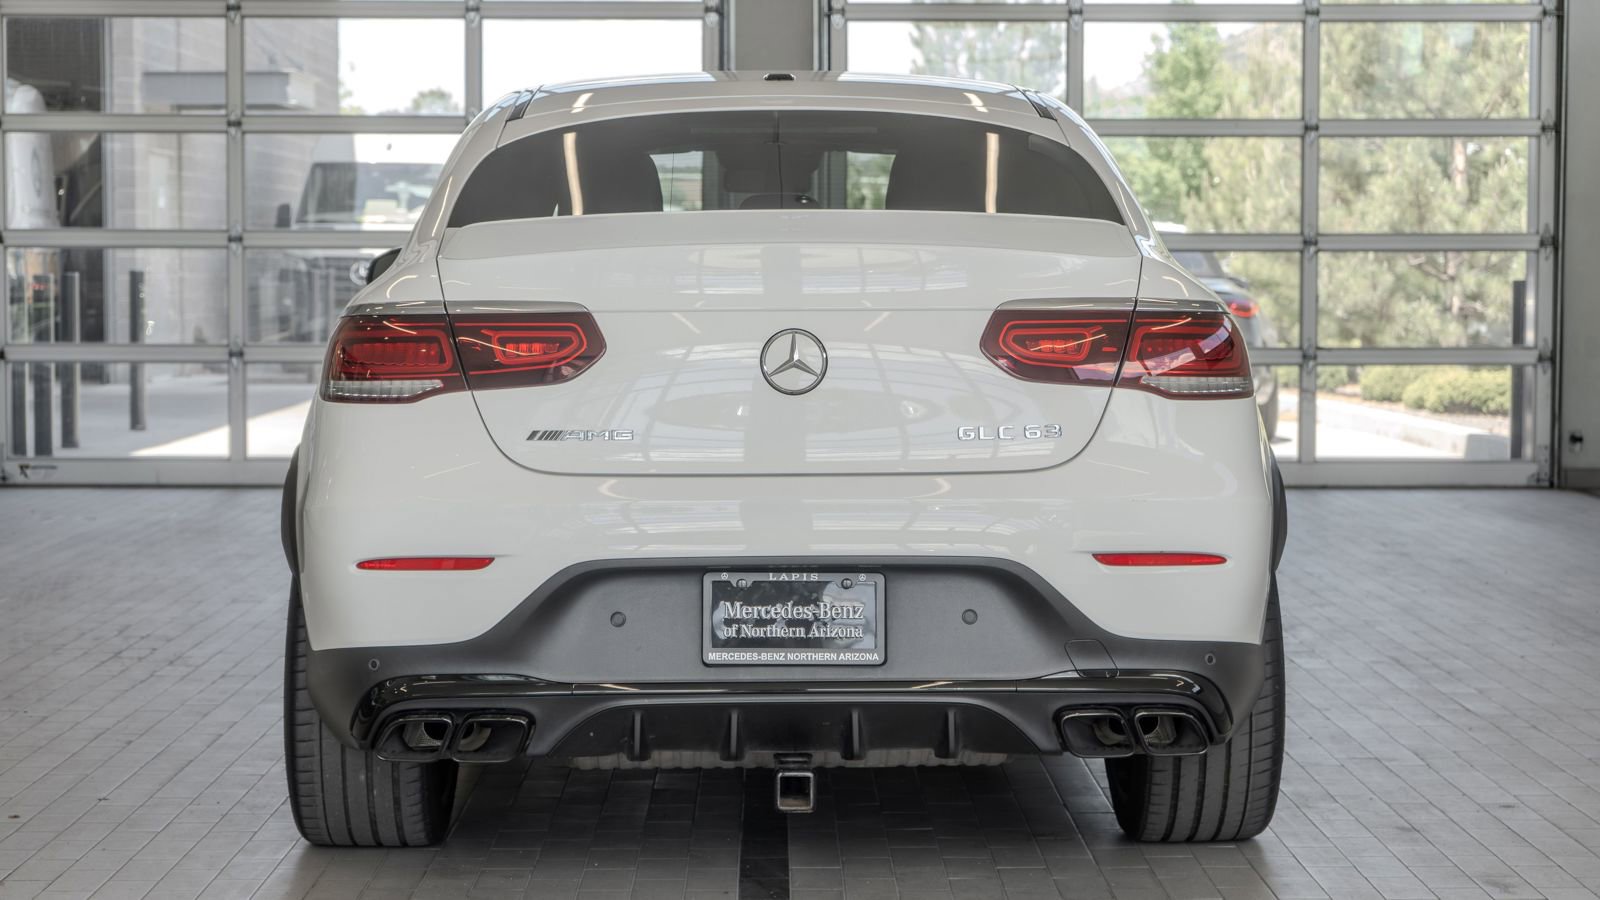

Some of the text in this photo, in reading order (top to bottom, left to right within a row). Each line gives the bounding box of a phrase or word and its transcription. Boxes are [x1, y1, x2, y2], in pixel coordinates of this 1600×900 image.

[561, 430, 634, 441] AMG
[958, 424, 1062, 440] GLC 63
[769, 573, 819, 581] LAPIS
[724, 601, 864, 619] Mercedes-Benz
[724, 624, 864, 638] of Northern Arizona
[708, 652, 879, 661] MERCEDES-BENZ NORTHERN ARIZONA
